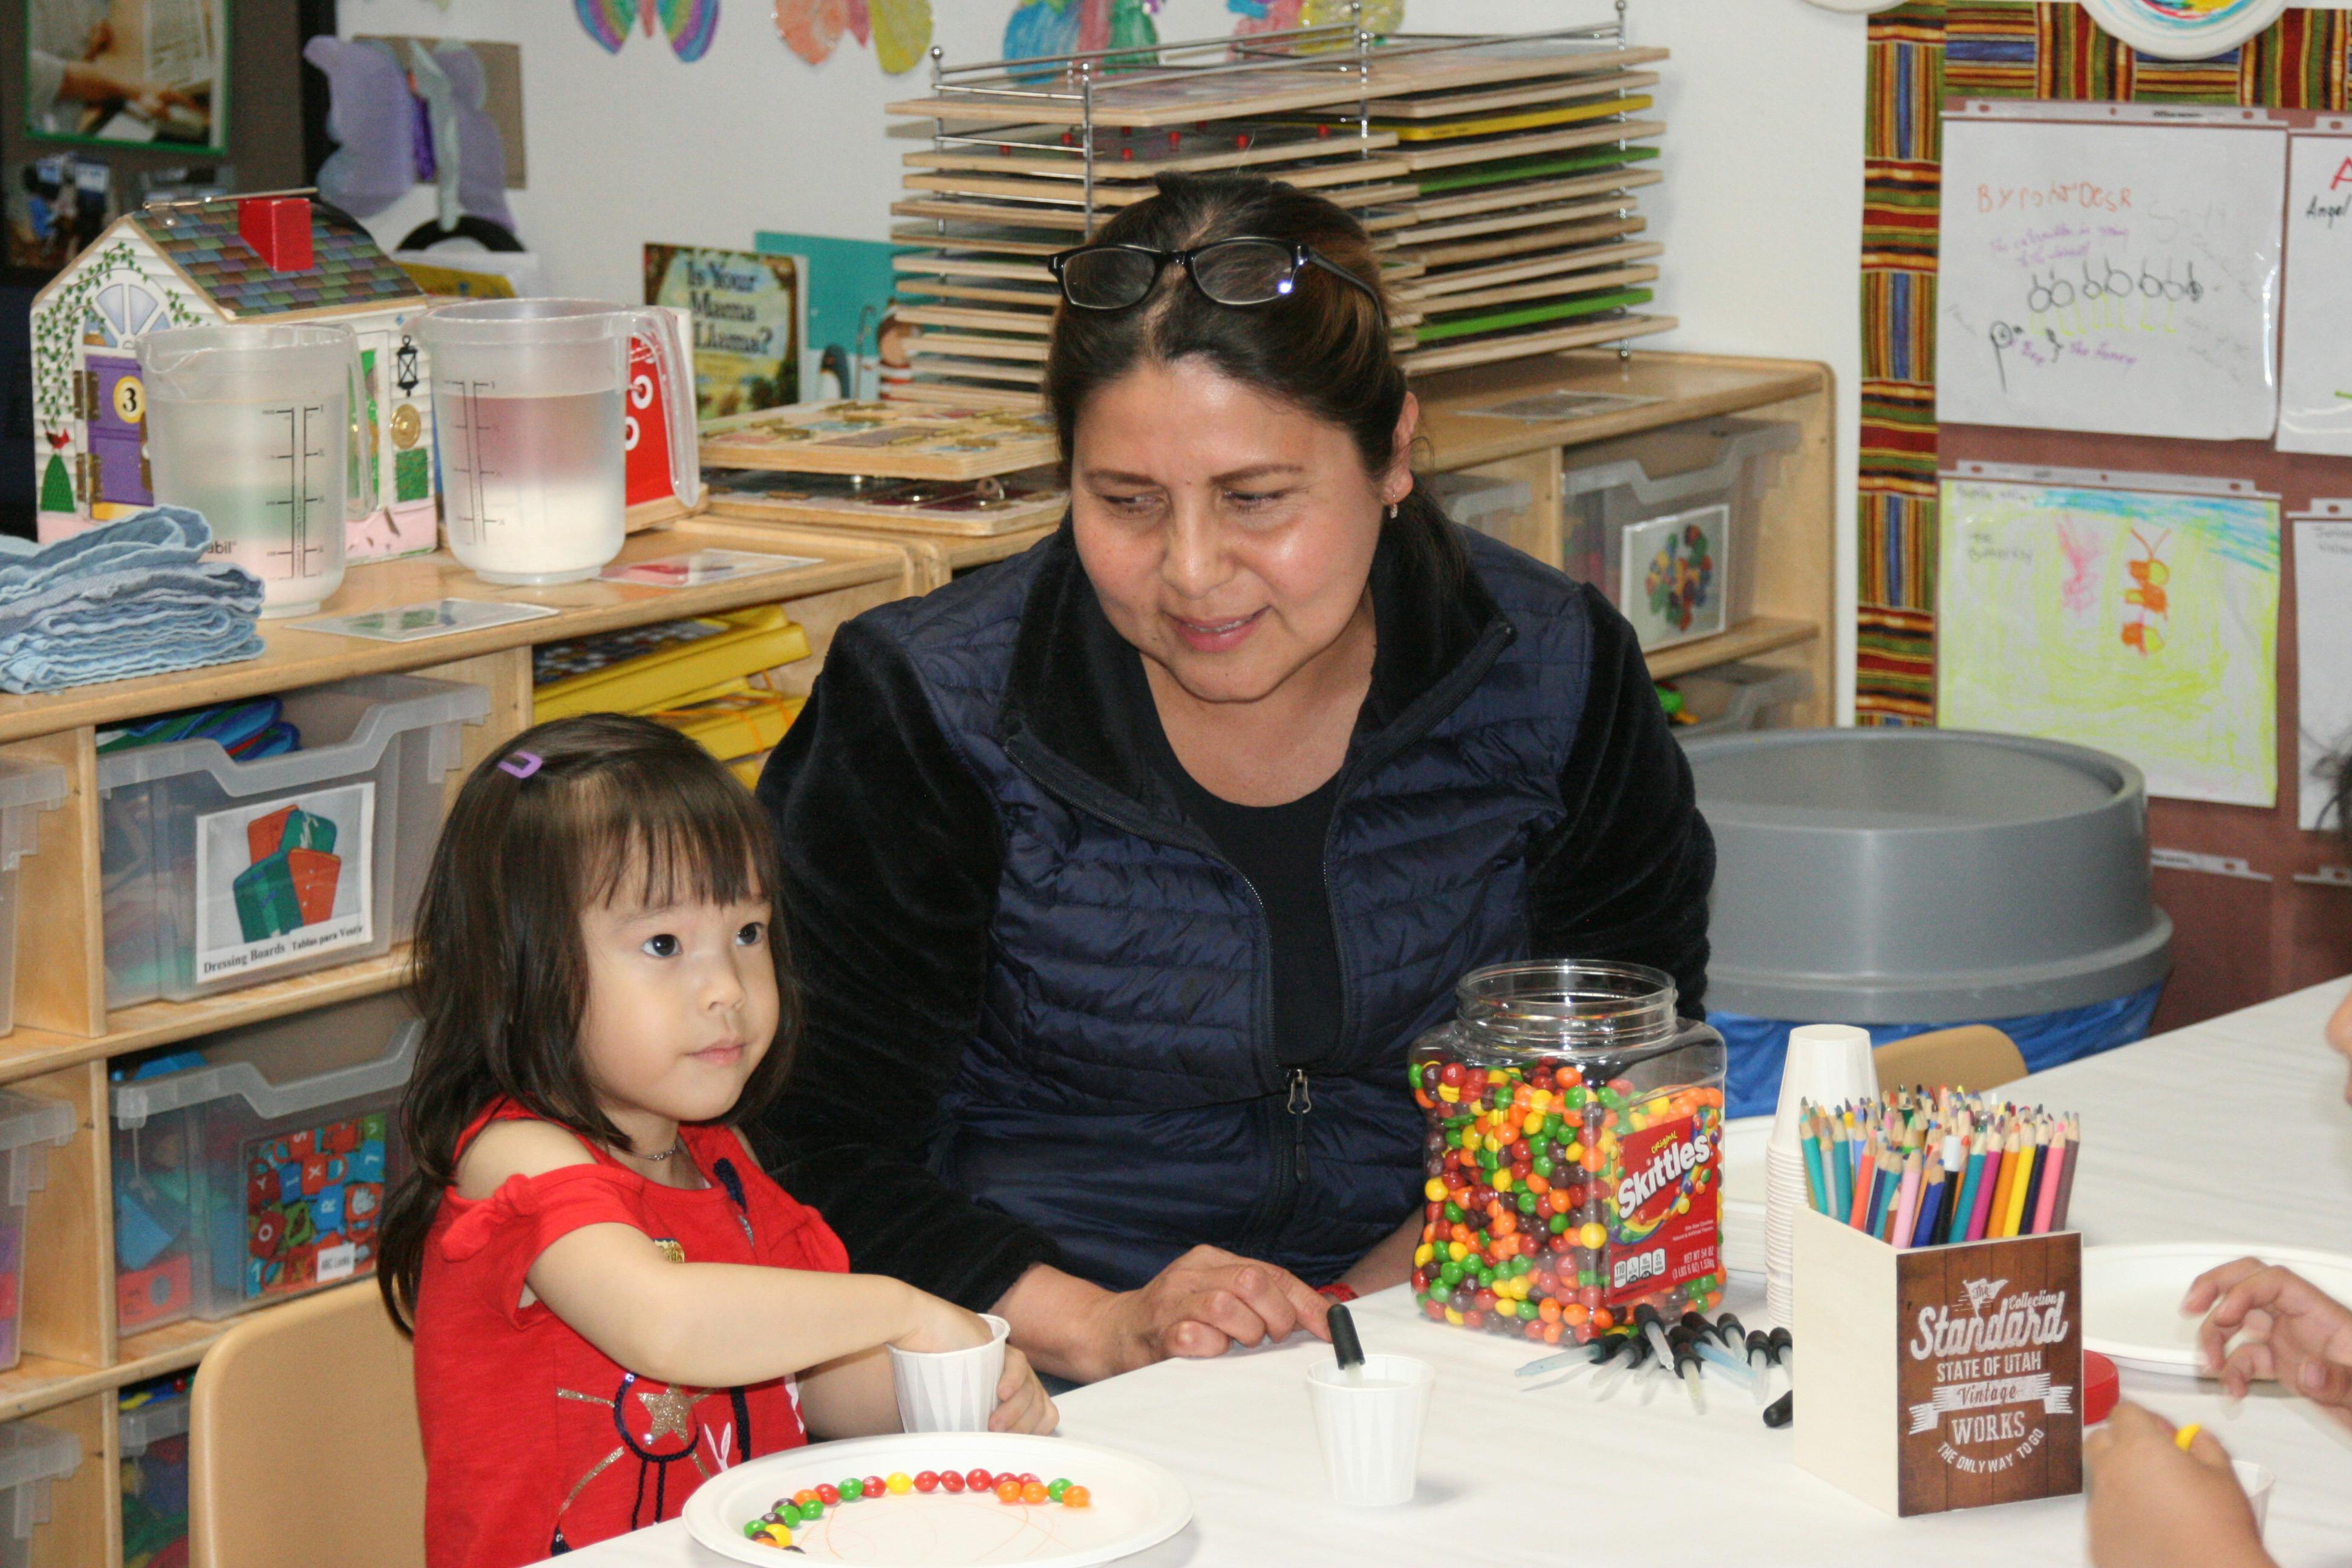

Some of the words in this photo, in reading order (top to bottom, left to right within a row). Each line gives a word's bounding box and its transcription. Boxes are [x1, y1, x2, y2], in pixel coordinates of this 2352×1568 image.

[687, 260, 706, 286] Is
[707, 260, 756, 292] Your
[690, 290, 756, 322] Mama
[694, 321, 772, 354] Llama?
[122, 387, 137, 413] 3
[204, 953, 249, 975] Dressing
[250, 942, 286, 961] Boards
[1618, 1134, 1711, 1220] Skittles
[2008, 1291, 2057, 1310] Collection
[1910, 1290, 2068, 1361] Standard
[1936, 1359, 1980, 1383] STATE
[1984, 1356, 2002, 1376] OF
[2004, 1350, 2042, 1374] UTAH
[1957, 1383, 2017, 1407] Vintage
[1951, 1411, 2025, 1445] WORKS
[1937, 1441, 1958, 1464] THE
[1956, 1455, 1986, 1473] ONLY
[1987, 1453, 2013, 1473] WAY
[2016, 1442, 2033, 1459] TO
[2028, 1428, 2045, 1446] GO
